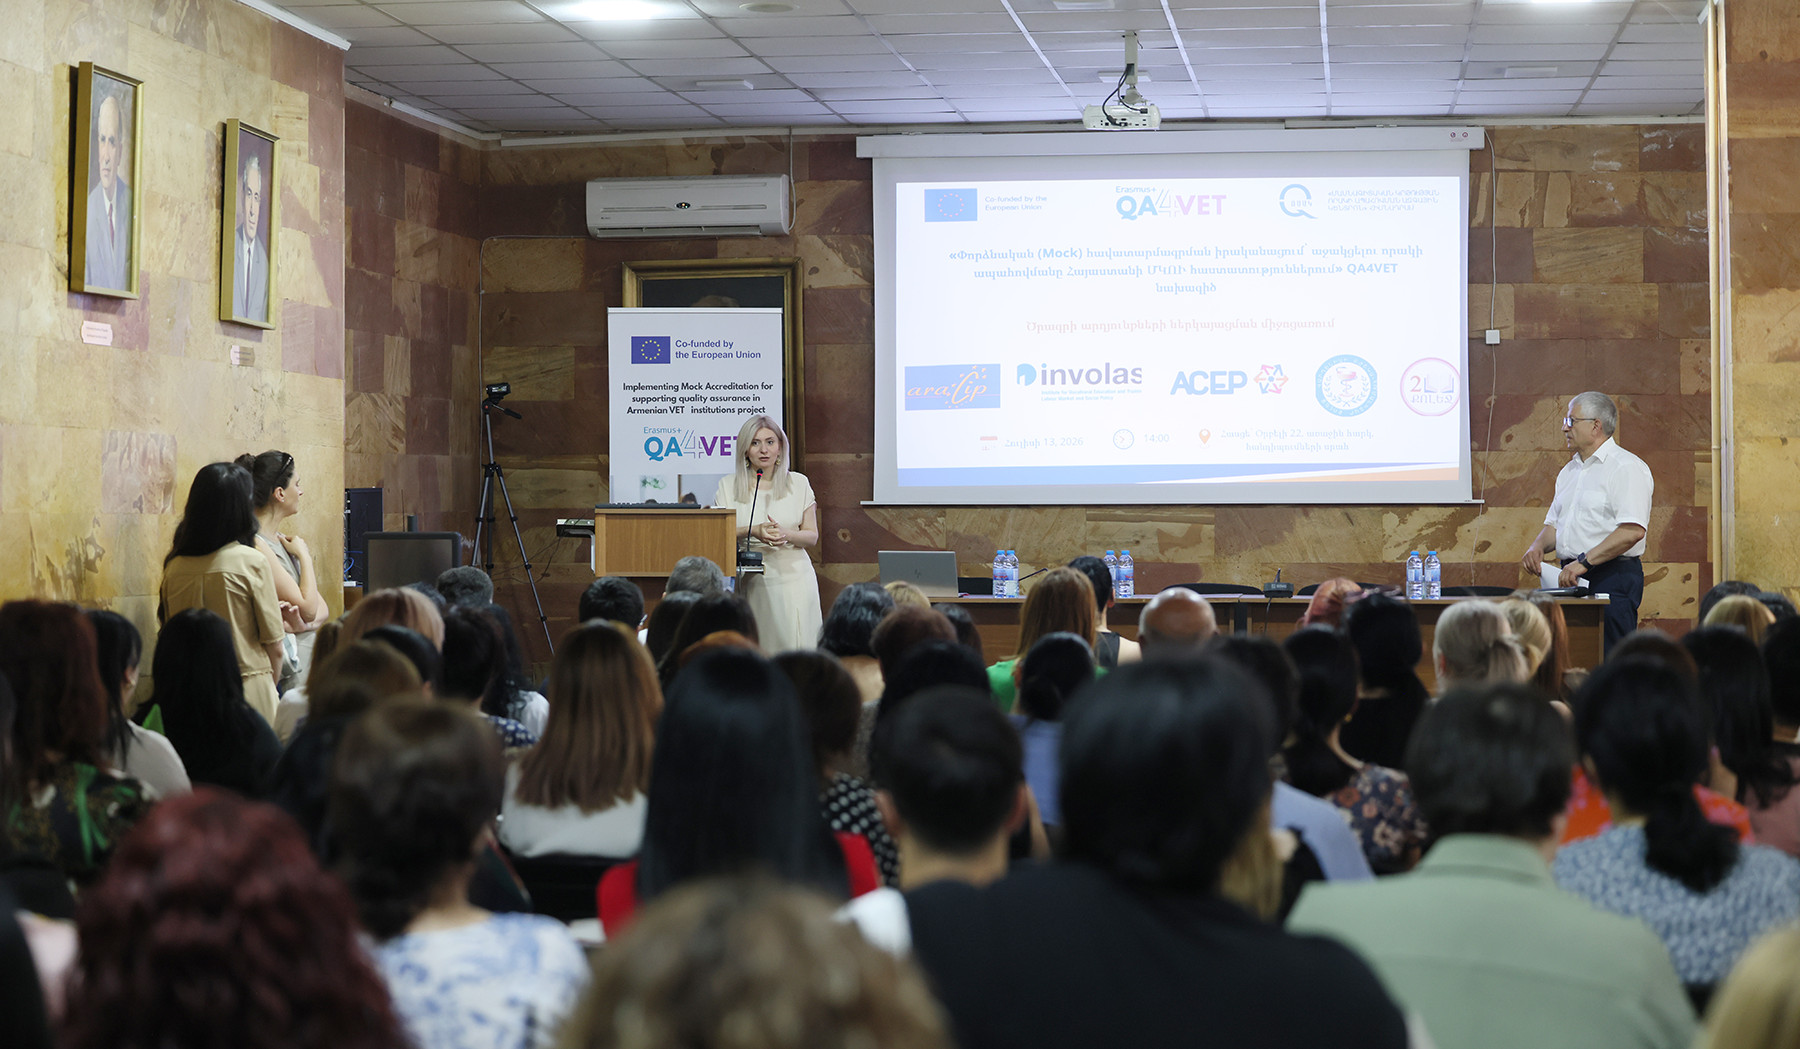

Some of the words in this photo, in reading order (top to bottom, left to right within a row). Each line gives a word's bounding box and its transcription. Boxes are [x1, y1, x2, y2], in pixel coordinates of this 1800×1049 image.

[1115, 185, 1157, 193] Erasmus+
[984, 195, 1022, 203] Co-funded
[1024, 195, 1033, 204] by
[1115, 188, 1227, 220] QA4VET
[984, 204, 1019, 212] European
[948, 248, 1034, 263] «Փորձնական
[1037, 247, 1083, 261] (Mock)
[1086, 246, 1212, 261] հավատարմագրման
[1311, 245, 1377, 259] աջակցելու
[1381, 245, 1424, 259] որակի
[973, 266, 1064, 280] ապահովմանը
[1066, 265, 1143, 279] Հայաստանի
[1346, 262, 1399, 275] QA4VET
[1155, 282, 1217, 296] նախագիծ
[1025, 319, 1078, 334] Ծրագրի
[1080, 318, 1168, 334] արդյունքների
[1169, 318, 1258, 333] ներկայացման
[1260, 317, 1337, 333] միջոցառում
[674, 339, 721, 349] Co-funded
[722, 339, 734, 350] by
[675, 350, 690, 359] the
[691, 350, 734, 361] European
[735, 350, 762, 359] Union
[1041, 362, 1143, 386] involas
[622, 382, 680, 393] Implementing
[680, 382, 704, 391] Mock
[705, 382, 759, 391] Accreditation
[760, 382, 774, 391] for
[1169, 370, 1248, 396] ACEP
[1409, 375, 1422, 393] 2
[631, 394, 677, 404] supporting
[678, 394, 708, 404] quality
[752, 394, 761, 402] in
[626, 406, 668, 414] Armenian
[669, 406, 685, 414] VET
[690, 406, 736, 414] institutions
[737, 406, 766, 416] project
[643, 426, 682, 434] Erasmus+
[1043, 437, 1057, 448] 13,
[1060, 437, 1084, 446] 2026
[1143, 433, 1170, 443] 14:00
[643, 429, 738, 462] QA4VE
